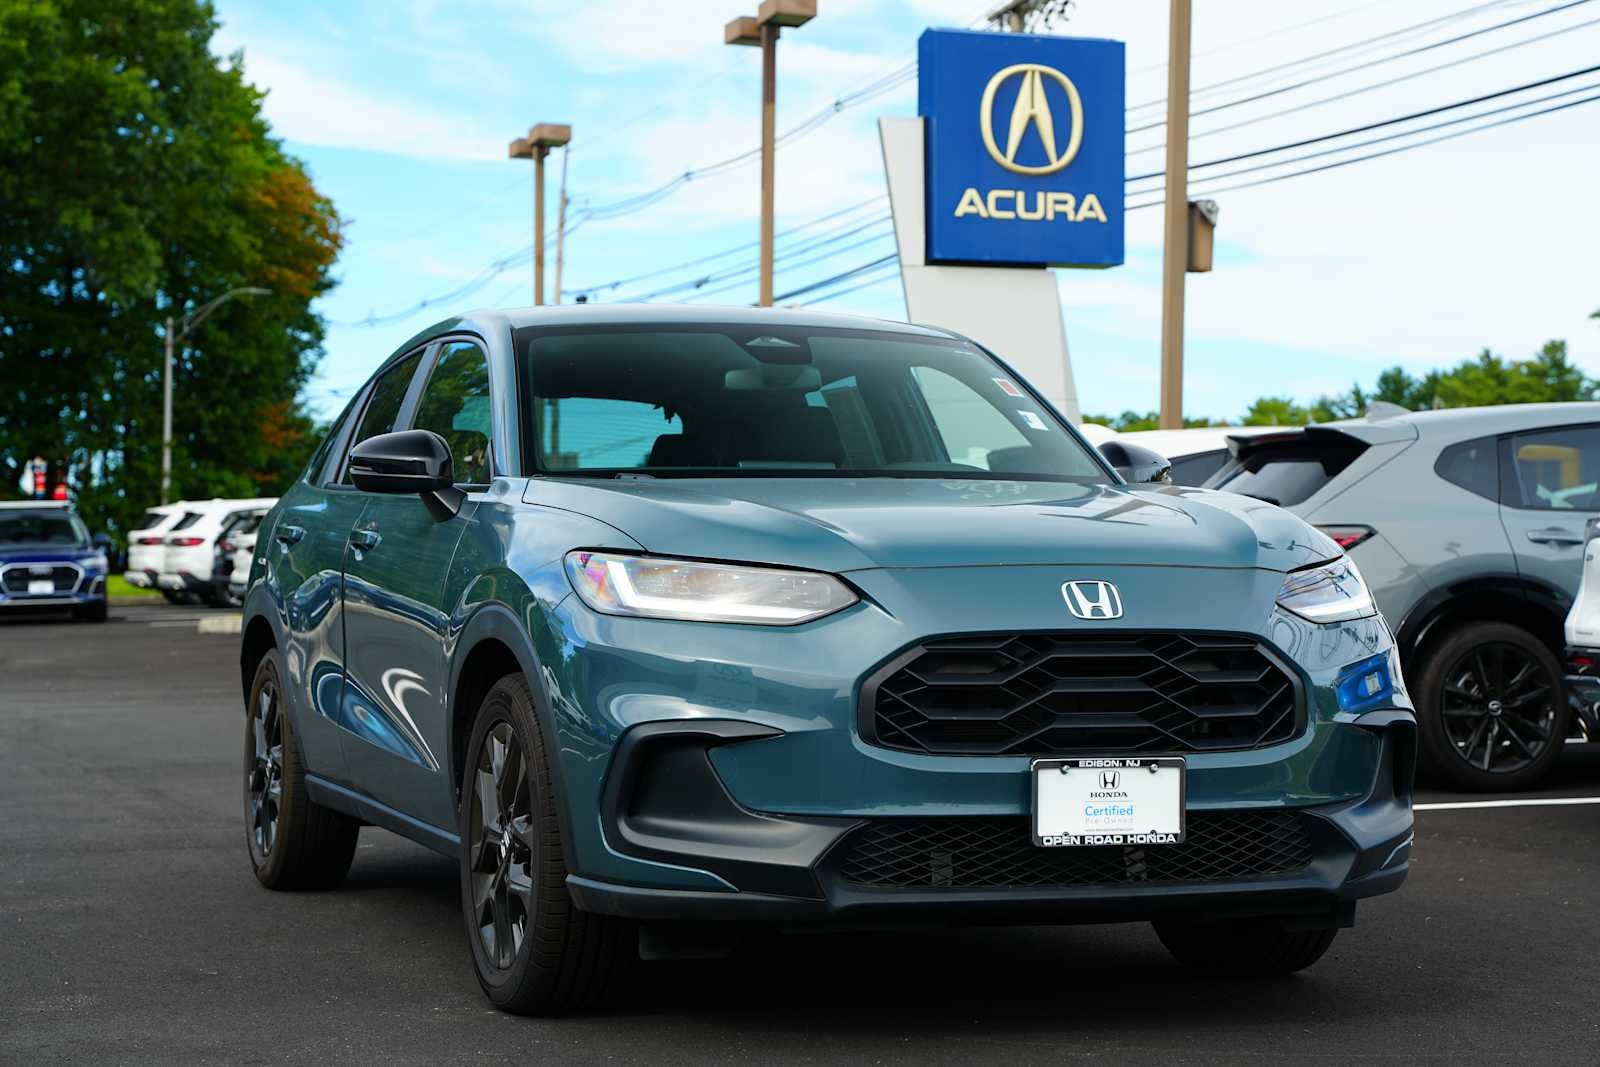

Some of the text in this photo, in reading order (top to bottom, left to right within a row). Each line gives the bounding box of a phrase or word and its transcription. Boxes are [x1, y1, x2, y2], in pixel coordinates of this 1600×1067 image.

[954, 188, 1108, 223] ACURA
[1078, 759, 1141, 768] EDISON, NJ
[1090, 791, 1128, 799] HONDA
[1085, 805, 1134, 816] Certified
[1042, 834, 1176, 846] OPEN ROAD HONDA
